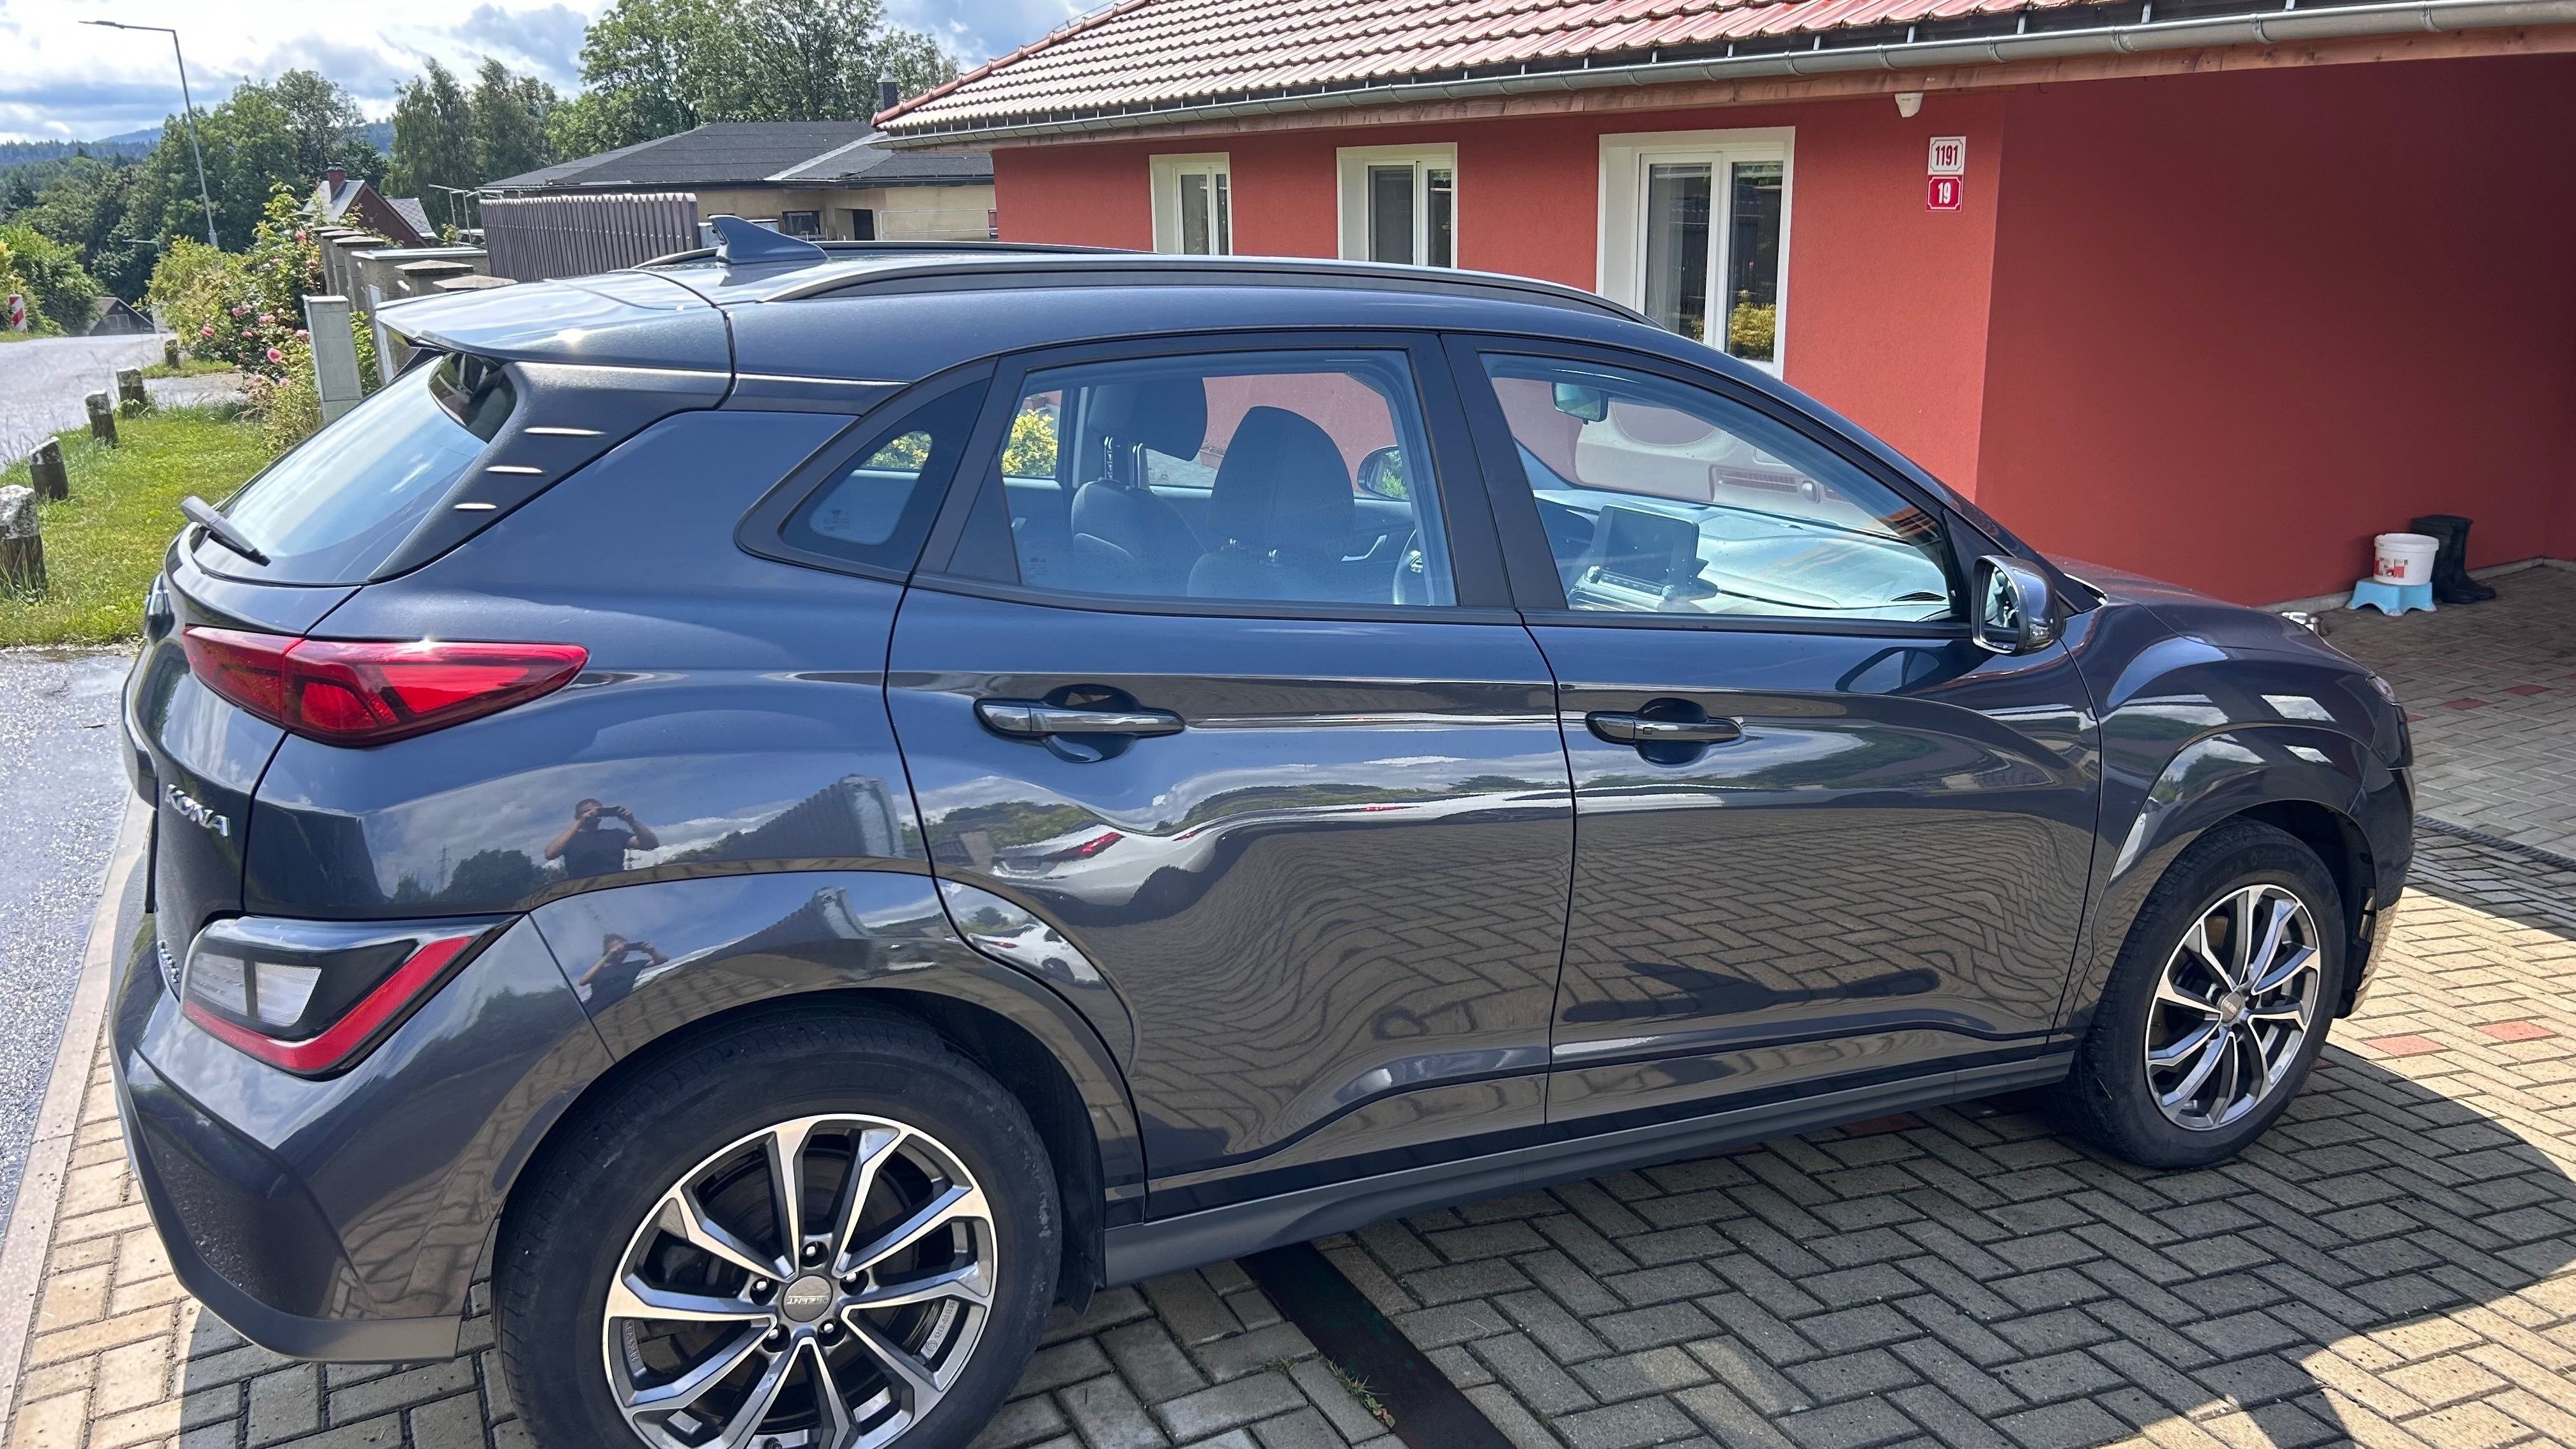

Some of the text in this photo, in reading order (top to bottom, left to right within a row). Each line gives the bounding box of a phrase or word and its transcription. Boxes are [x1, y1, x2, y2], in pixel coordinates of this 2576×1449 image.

[1935, 144, 1958, 166] 1191
[1938, 181, 1952, 204] 19
[165, 784, 231, 838] KONA
[787, 1296, 829, 1305] DEZENT
